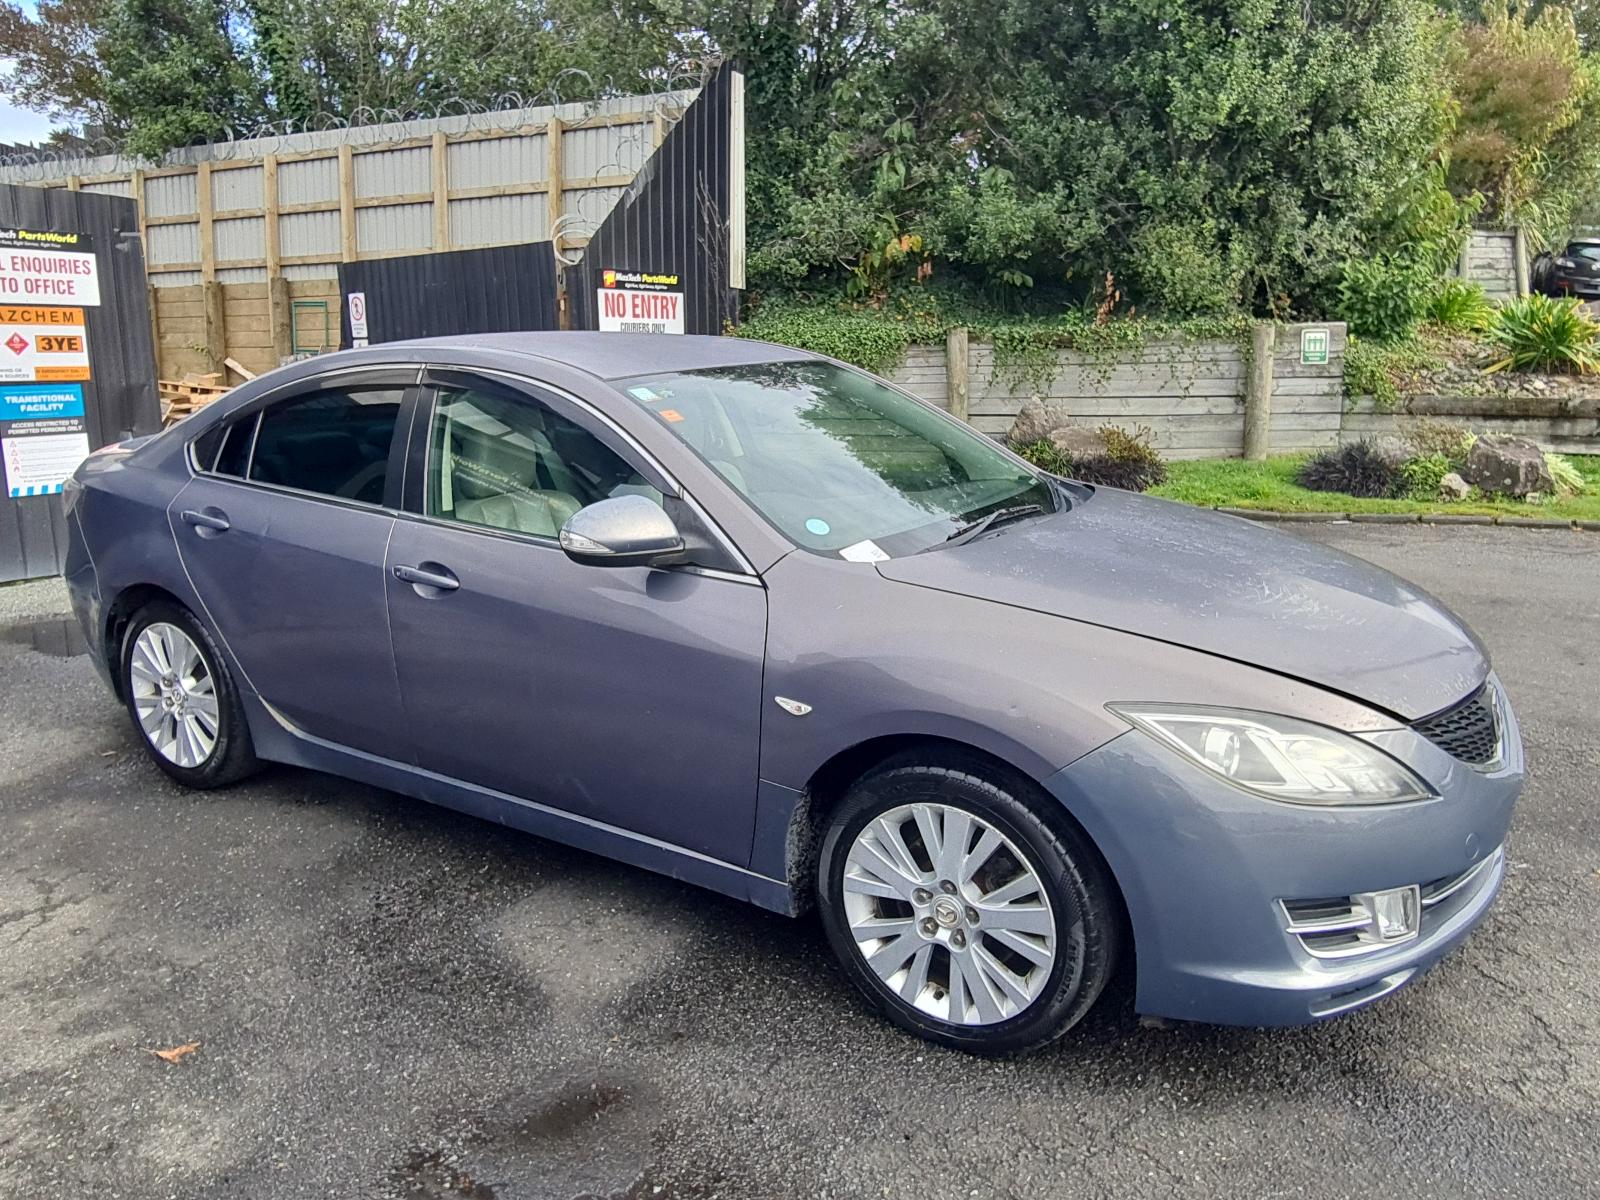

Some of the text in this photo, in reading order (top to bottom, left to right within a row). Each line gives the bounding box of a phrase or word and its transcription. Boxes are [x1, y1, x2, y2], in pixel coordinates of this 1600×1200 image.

[0, 230, 78, 243] ech PartsWorld
[11, 256, 91, 275] ENQUIRIES
[642, 274, 678, 284] PartsWorld
[0, 277, 75, 295] TO OFFICE
[604, 292, 678, 320] NO ENTRY
[620, 322, 666, 334] COURIERS ONLY
[41, 338, 78, 351] 3YE
[4, 394, 76, 404] TRANSITIONAL
[20, 403, 64, 412] FACILITY
